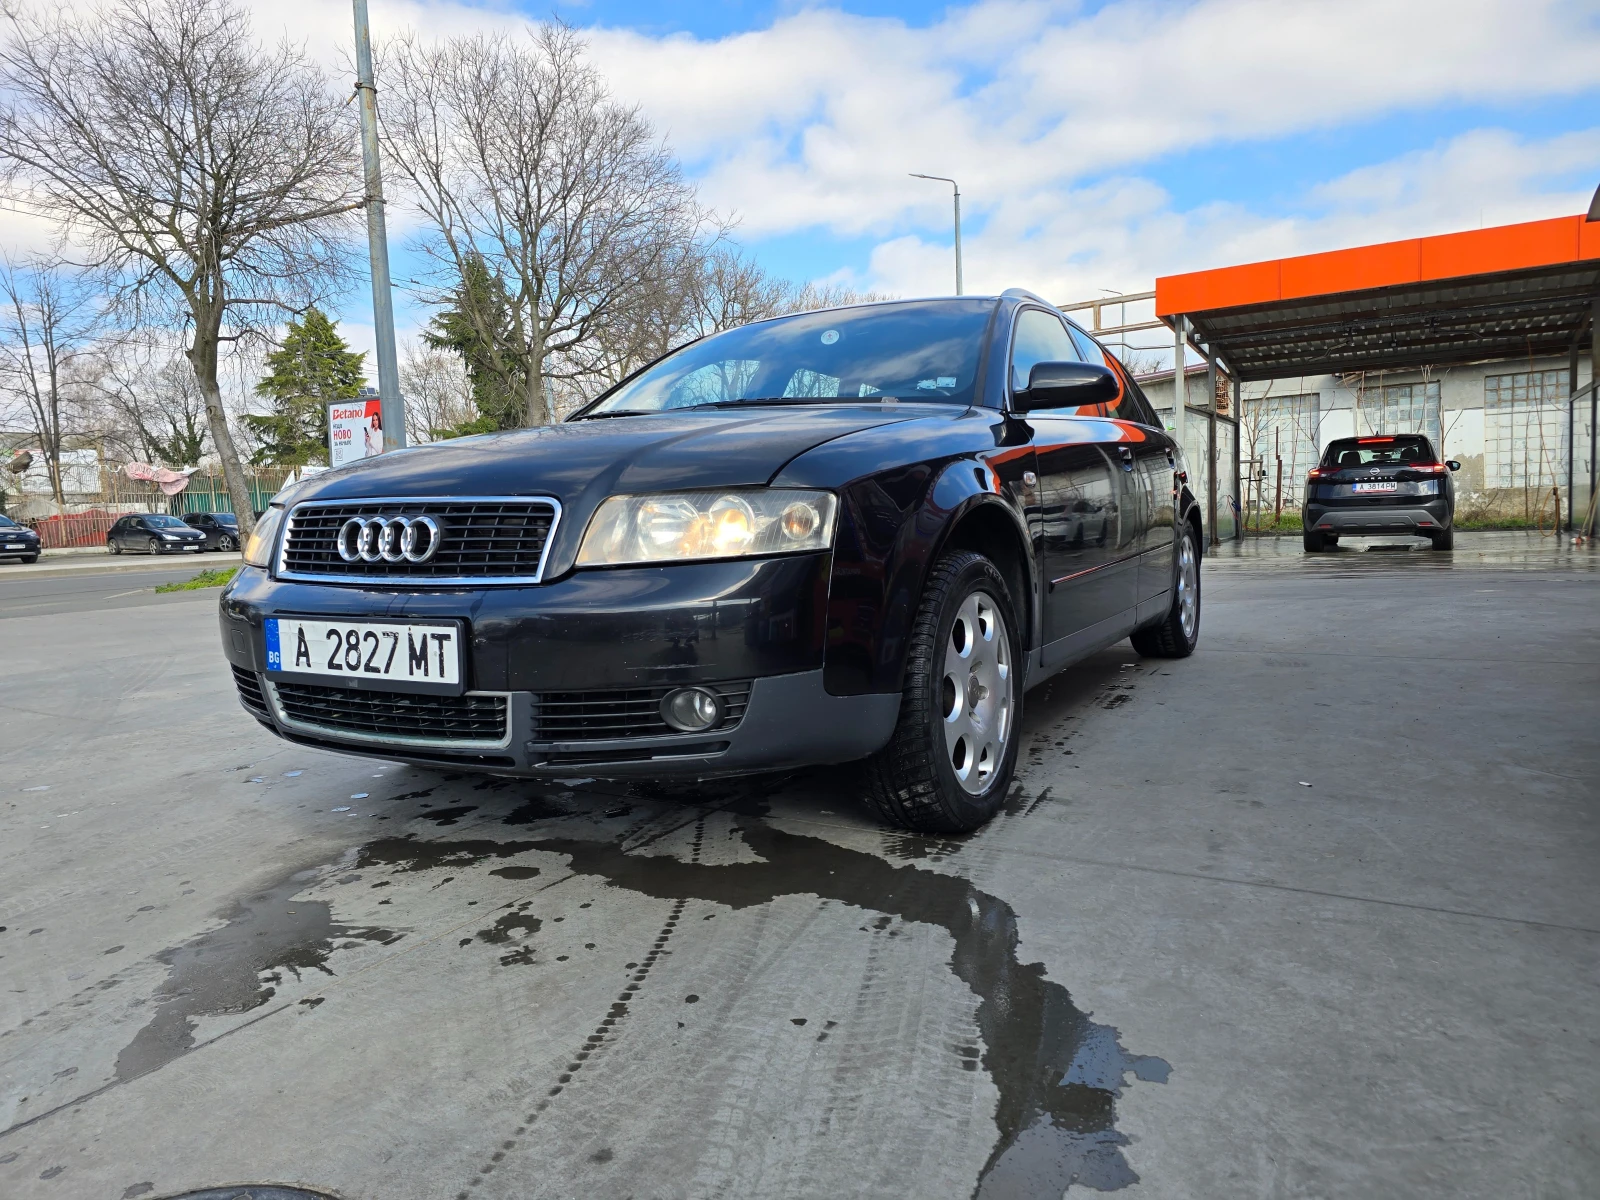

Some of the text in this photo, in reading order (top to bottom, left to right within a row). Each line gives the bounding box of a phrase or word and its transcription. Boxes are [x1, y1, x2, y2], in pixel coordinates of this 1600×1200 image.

[333, 409, 362, 420] Betano
[333, 429, 351, 440] НОВО
[269, 651, 280, 664] BG
[296, 627, 451, 677] A 2827 MT
